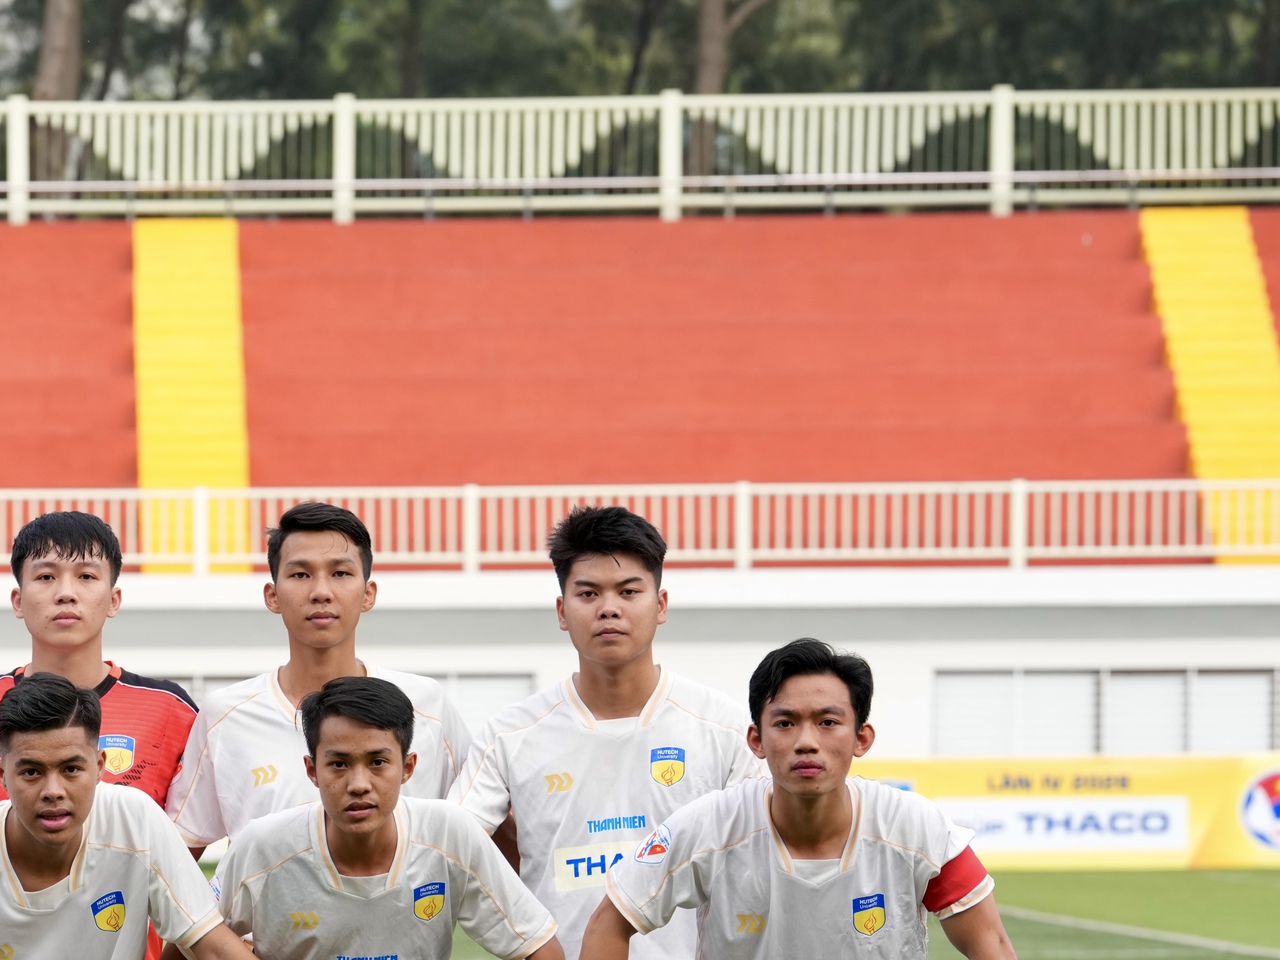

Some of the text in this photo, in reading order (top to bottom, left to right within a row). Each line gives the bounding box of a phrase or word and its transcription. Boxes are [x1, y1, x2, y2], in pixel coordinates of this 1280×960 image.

[587, 817, 622, 833] THANH
[1019, 812, 1170, 834] THACO
[420, 884, 439, 893] HUTECH
[96, 893, 116, 906] HUTECH
[859, 895, 878, 905] HUTECH
